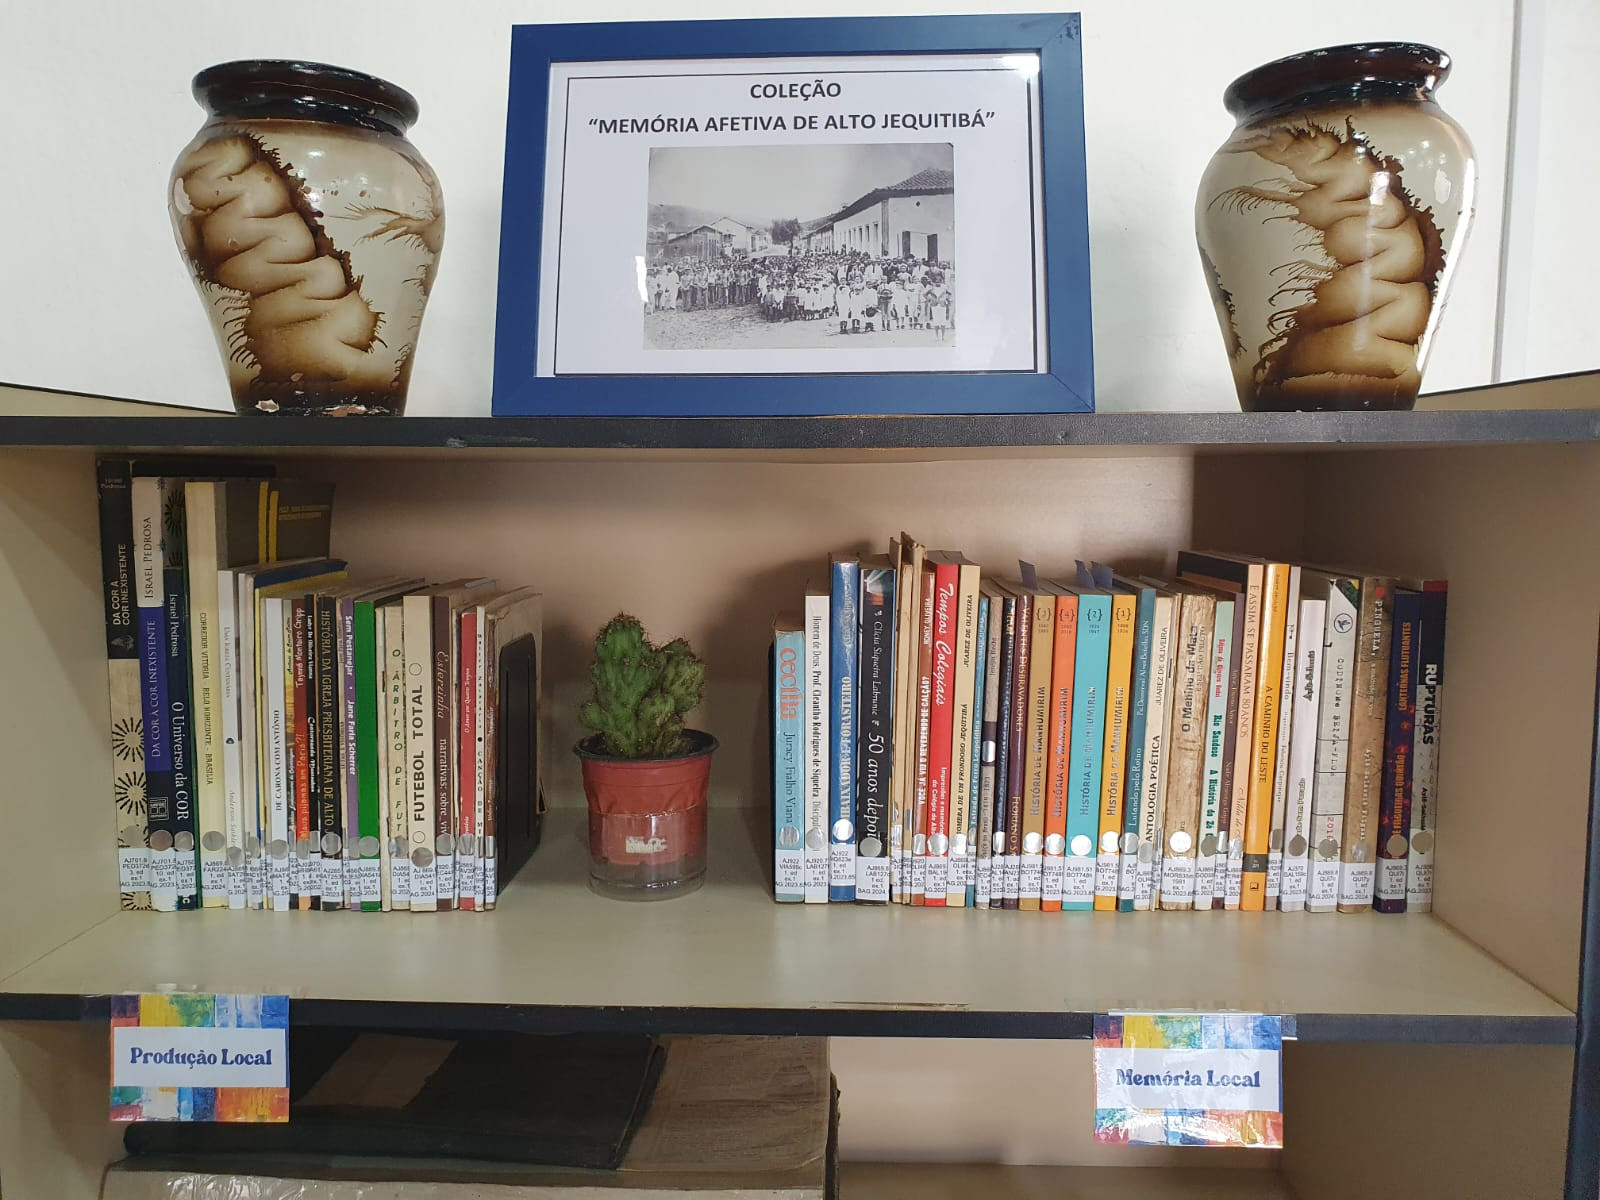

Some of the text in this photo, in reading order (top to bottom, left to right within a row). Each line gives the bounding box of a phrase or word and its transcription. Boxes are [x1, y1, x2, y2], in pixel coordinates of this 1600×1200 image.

[750, 80, 841, 102] COLEÇÃO
[588, 108, 996, 135] “MEMÓRIA AFETIVA DE ALTO JEQUITIBÁ”
[118, 544, 130, 626] COR INEXISTENTE
[169, 594, 179, 619] Israel
[111, 590, 122, 625] DA COR
[812, 616, 822, 641] Homem
[965, 595, 973, 627] OLIVEIRA
[1247, 593, 1257, 623] ASSIM
[199, 612, 208, 649] CORREDOR
[293, 607, 304, 661] Monteiro Gripp
[345, 616, 354, 676] Sem Pestanejar
[935, 583, 954, 706] Tempos Colegiais
[964, 629, 971, 638] DE
[1247, 628, 1255, 639] SE
[870, 647, 882, 678] Siqueira
[1155, 627, 1168, 705] JUAREZ DE OLIVEIRA
[1243, 643, 1253, 695] PASSARAM
[1398, 622, 1411, 711] LANTERNAS FLUTUANTES
[146, 620, 161, 757] DA COR COR INEXISTENTE
[202, 687, 211, 705] BELO
[812, 689, 822, 720] Cleantho
[840, 677, 851, 743] FORASTEIRO
[871, 680, 882, 716] Labrunie
[1015, 656, 1028, 732] DESBRAVADORES
[1183, 677, 1195, 719] Menino
[1242, 698, 1251, 709] 80
[1422, 664, 1438, 745] RUPTURAS
[203, 706, 212, 746] HORIZONTE
[272, 710, 281, 747] ANTÔNIO
[321, 611, 334, 826] HISTÓRIA DA IGREJA PRESBITERIANA DE ALTO
[347, 700, 357, 775] Jane Faria Scherrer
[1033, 686, 1045, 753] MANHUMIRIM
[1057, 687, 1068, 755] MANHUMIRIM
[1110, 687, 1124, 753] MANHUMIRIM
[1182, 723, 1191, 732] O
[1240, 710, 1250, 738] ANOS
[1263, 696, 1273, 739] CAMINHO
[171, 702, 189, 820] O Universo da COR
[411, 684, 425, 822] FUTEBOL TOTAL
[810, 722, 822, 757] Rodrigues
[957, 703, 968, 805] DE UM FRONDOSO JEQUITIBÁ
[1261, 742, 1270, 754] DO
[274, 766, 282, 799] CARONA
[784, 732, 797, 824] Juracy Fialho Viana
[810, 769, 822, 797] Siqueira
[812, 758, 822, 767] de
[1259, 757, 1269, 784] LESTE
[275, 800, 282, 811] DE
[438, 739, 450, 834] narrativas: sobre_viv
[864, 733, 885, 839] 50 anos depoi
[1029, 770, 1041, 816] HISTÓRIA
[1052, 772, 1064, 817] HISTÓRIA
[1079, 771, 1092, 816] HISTÓRIA
[1106, 771, 1119, 816] HISTÓRIA
[1127, 747, 1142, 826] Lutando pelo Reino
[1145, 735, 1160, 842] ANTOLOGIA POÉTICA
[1011, 796, 1021, 843] FLORIANO
[130, 1047, 272, 1069] Produção Local
[1116, 1069, 1260, 1088] Memória Local
